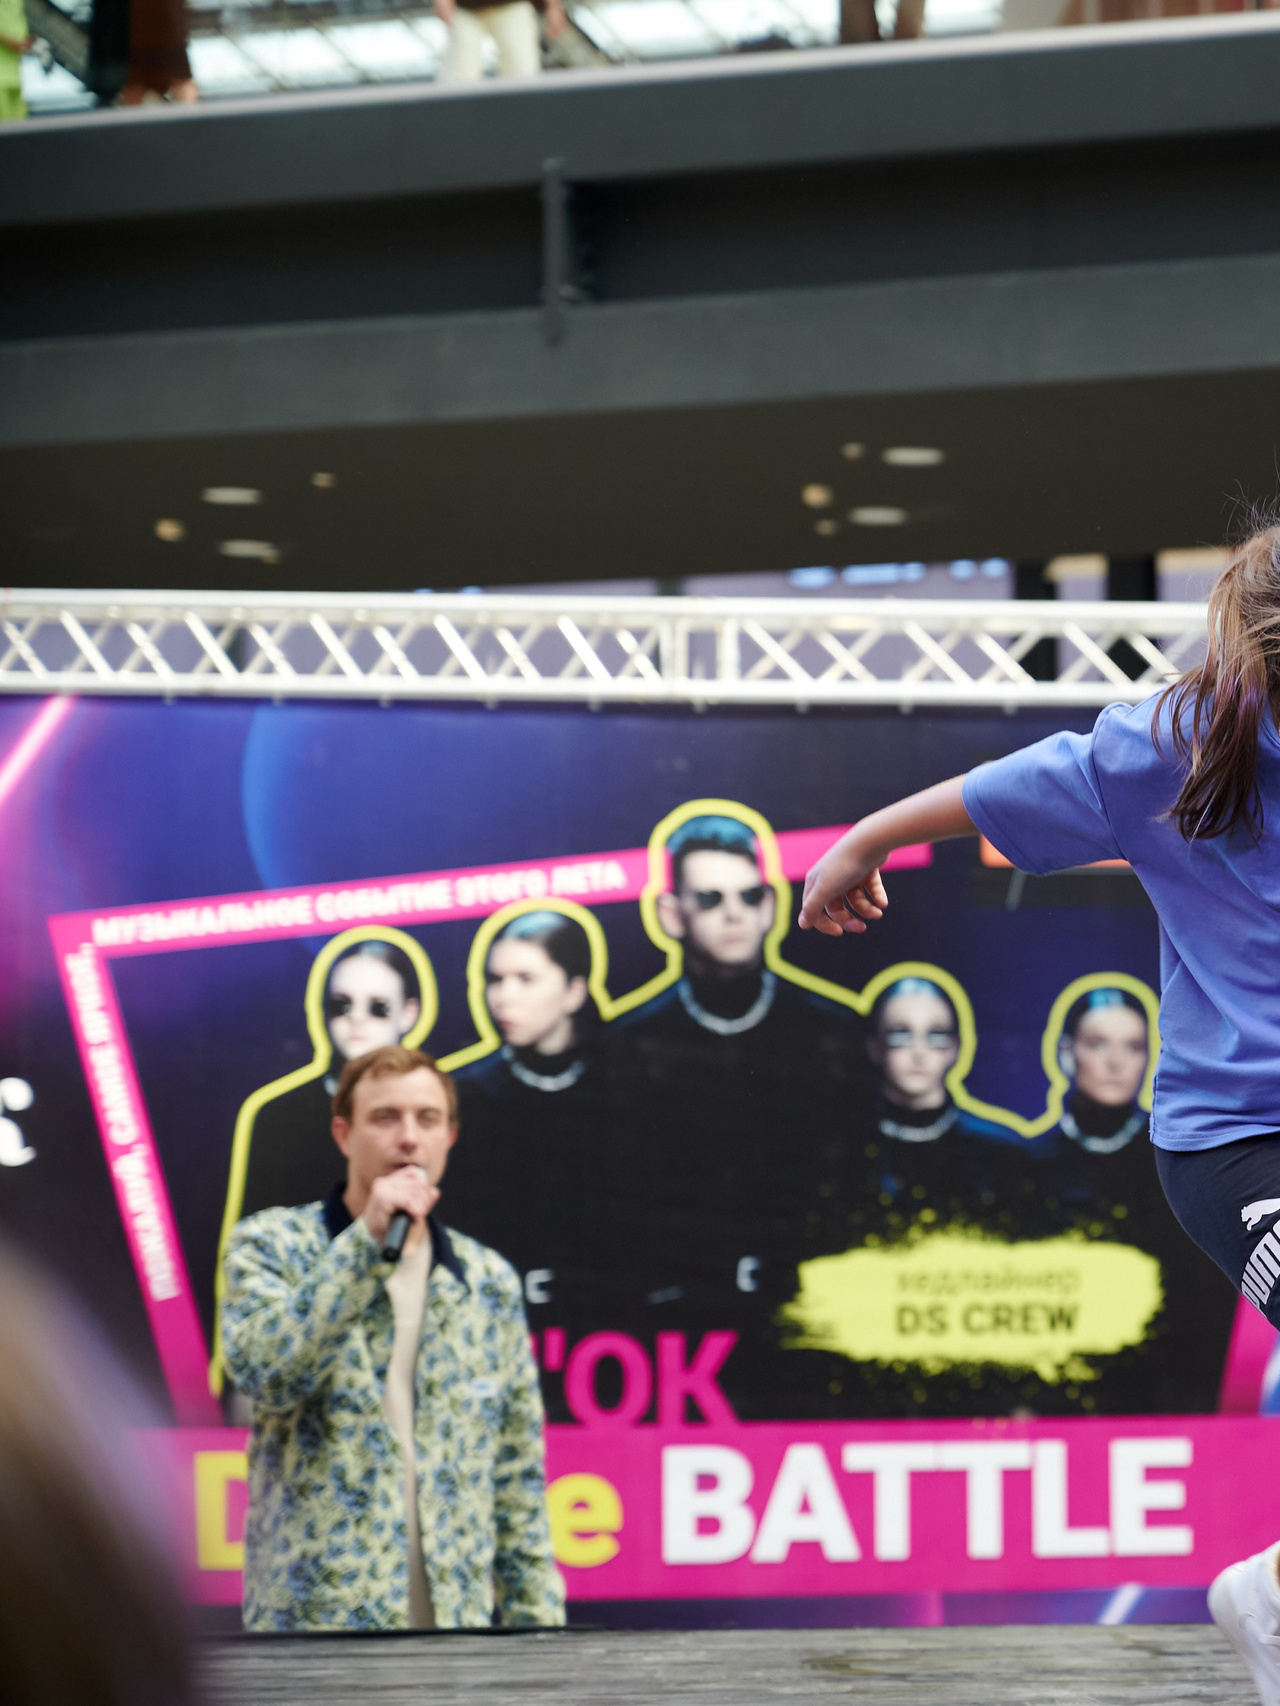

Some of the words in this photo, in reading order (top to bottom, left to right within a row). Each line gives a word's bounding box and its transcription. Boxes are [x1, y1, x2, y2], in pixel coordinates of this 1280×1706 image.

[92, 894, 313, 946] МУЗЫКАЛЬНОЕ
[314, 878, 452, 922] СОБЫТИЕ
[453, 868, 549, 907] ЭТОГО
[550, 859, 627, 896] ЛЕТА
[897, 1304, 948, 1337] DS
[962, 1303, 1080, 1337] CREW
[660, 1435, 1195, 1566] BATTLE
